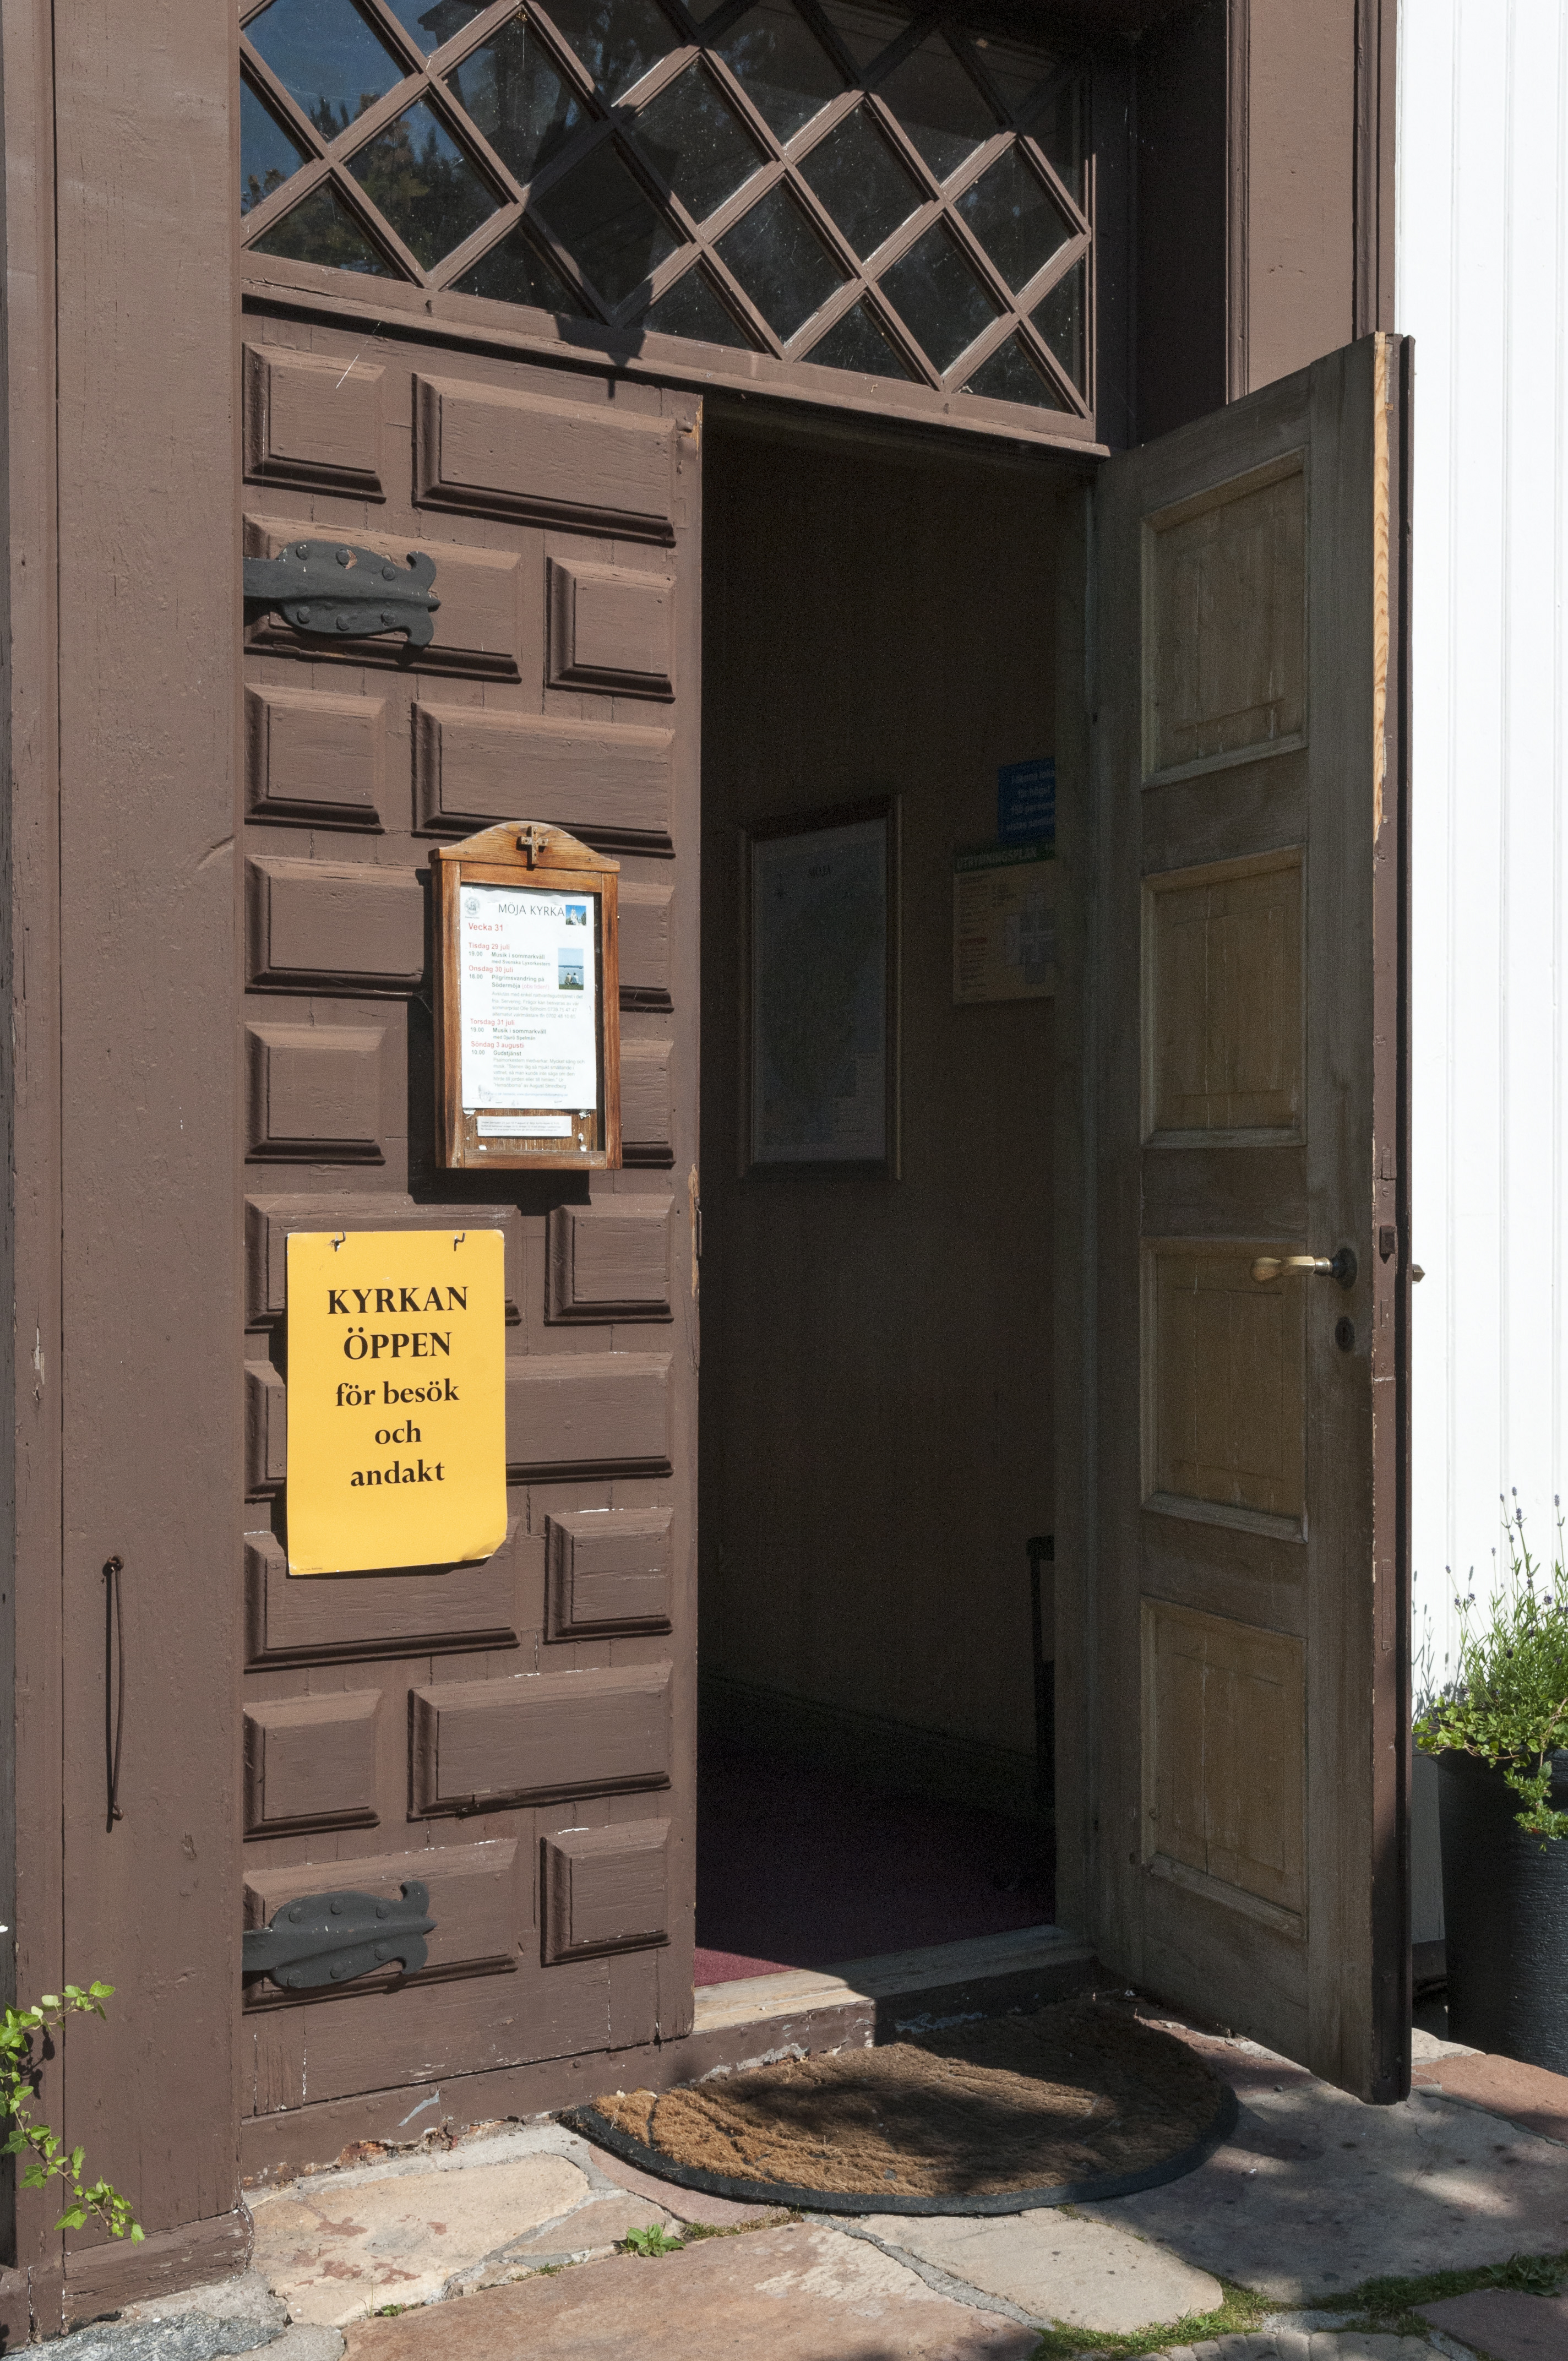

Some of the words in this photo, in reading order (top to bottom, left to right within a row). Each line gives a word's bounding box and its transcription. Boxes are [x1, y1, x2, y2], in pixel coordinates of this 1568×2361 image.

[499, 902, 526, 915] MÖJA
[531, 906, 565, 916] KYRKA
[469, 923, 492, 931] Vecka
[327, 1286, 469, 1314] KYRKAN
[344, 1327, 453, 1360] ÖPPEN
[335, 1382, 376, 1407] för
[384, 1379, 460, 1405] besök
[375, 1419, 422, 1444] och
[351, 1460, 445, 1486] andakt
